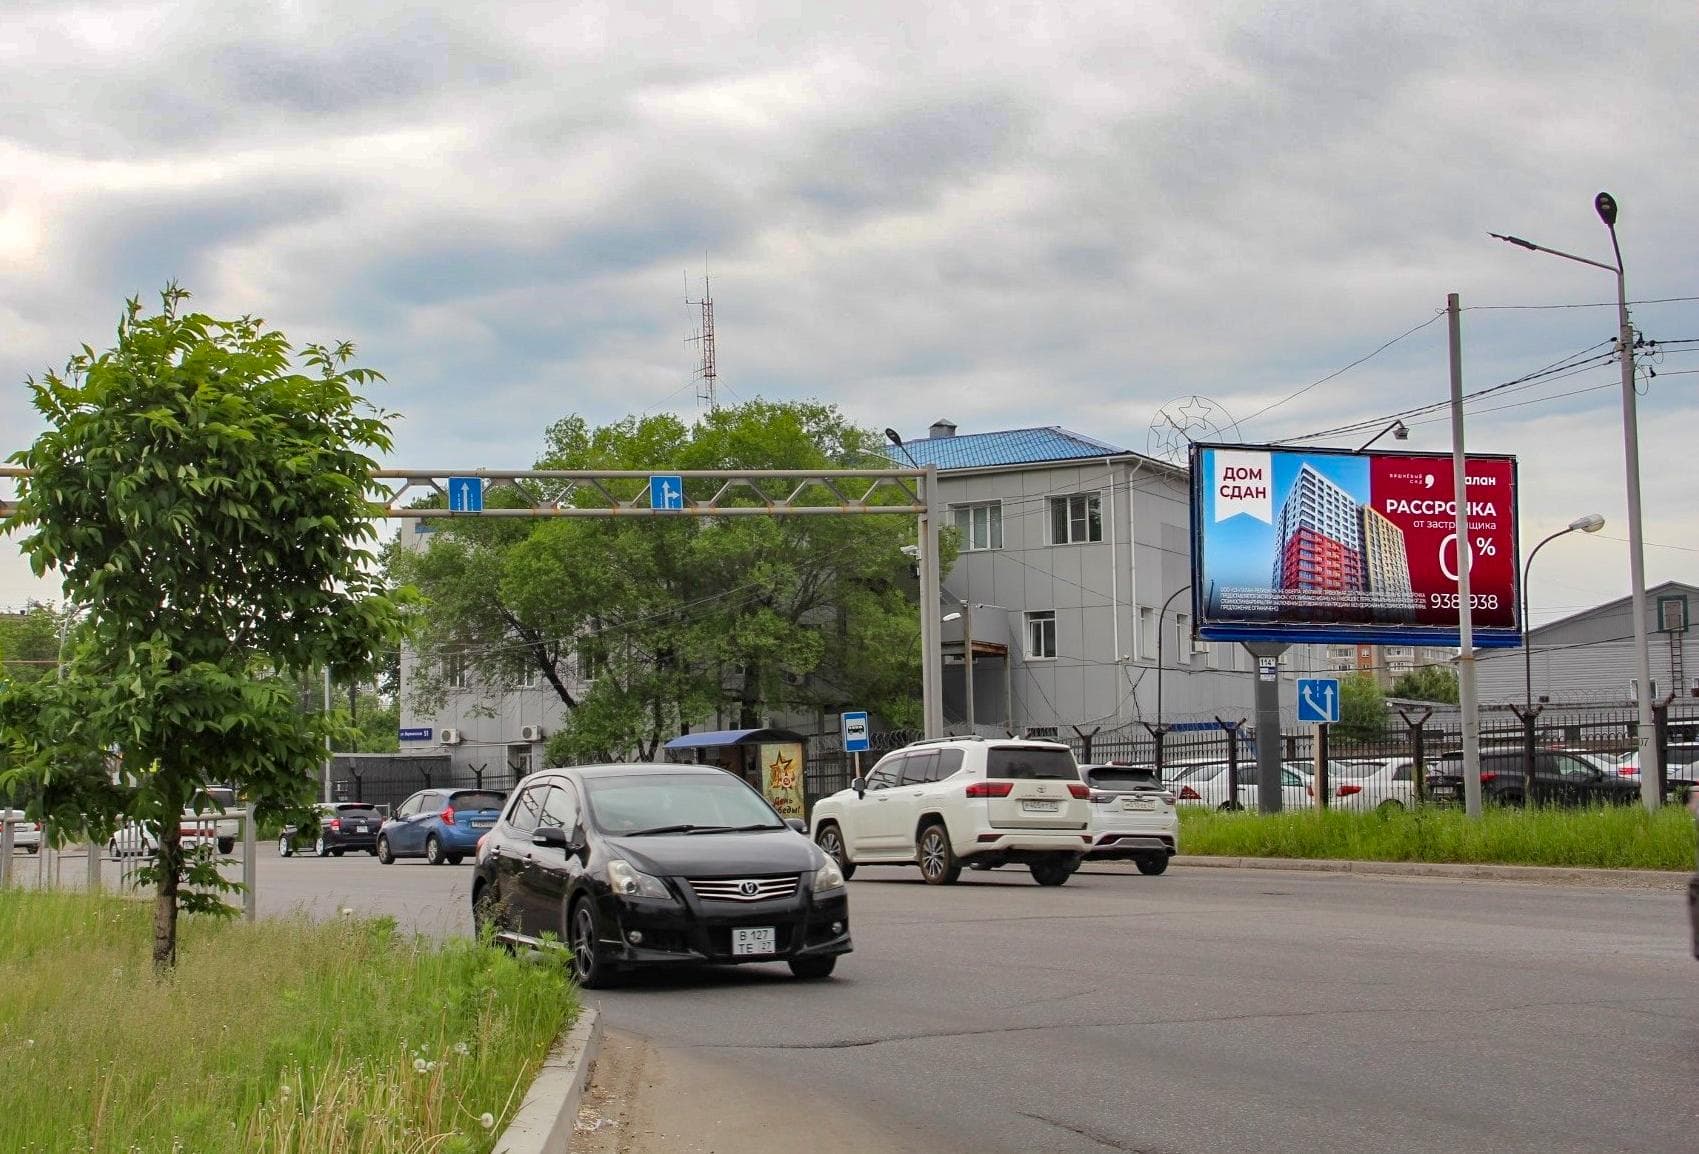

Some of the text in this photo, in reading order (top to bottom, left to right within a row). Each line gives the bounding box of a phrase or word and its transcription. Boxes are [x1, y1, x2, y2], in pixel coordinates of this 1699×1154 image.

[1223, 467, 1262, 482] ДОМ
[1464, 476, 1496, 486] алан
[1219, 485, 1266, 500] СДАН
[1413, 520, 1497, 531] от застрщика
[1430, 593, 1460, 609] 938
[751, 929, 769, 941] 127
[738, 943, 753, 953] ТЕ
